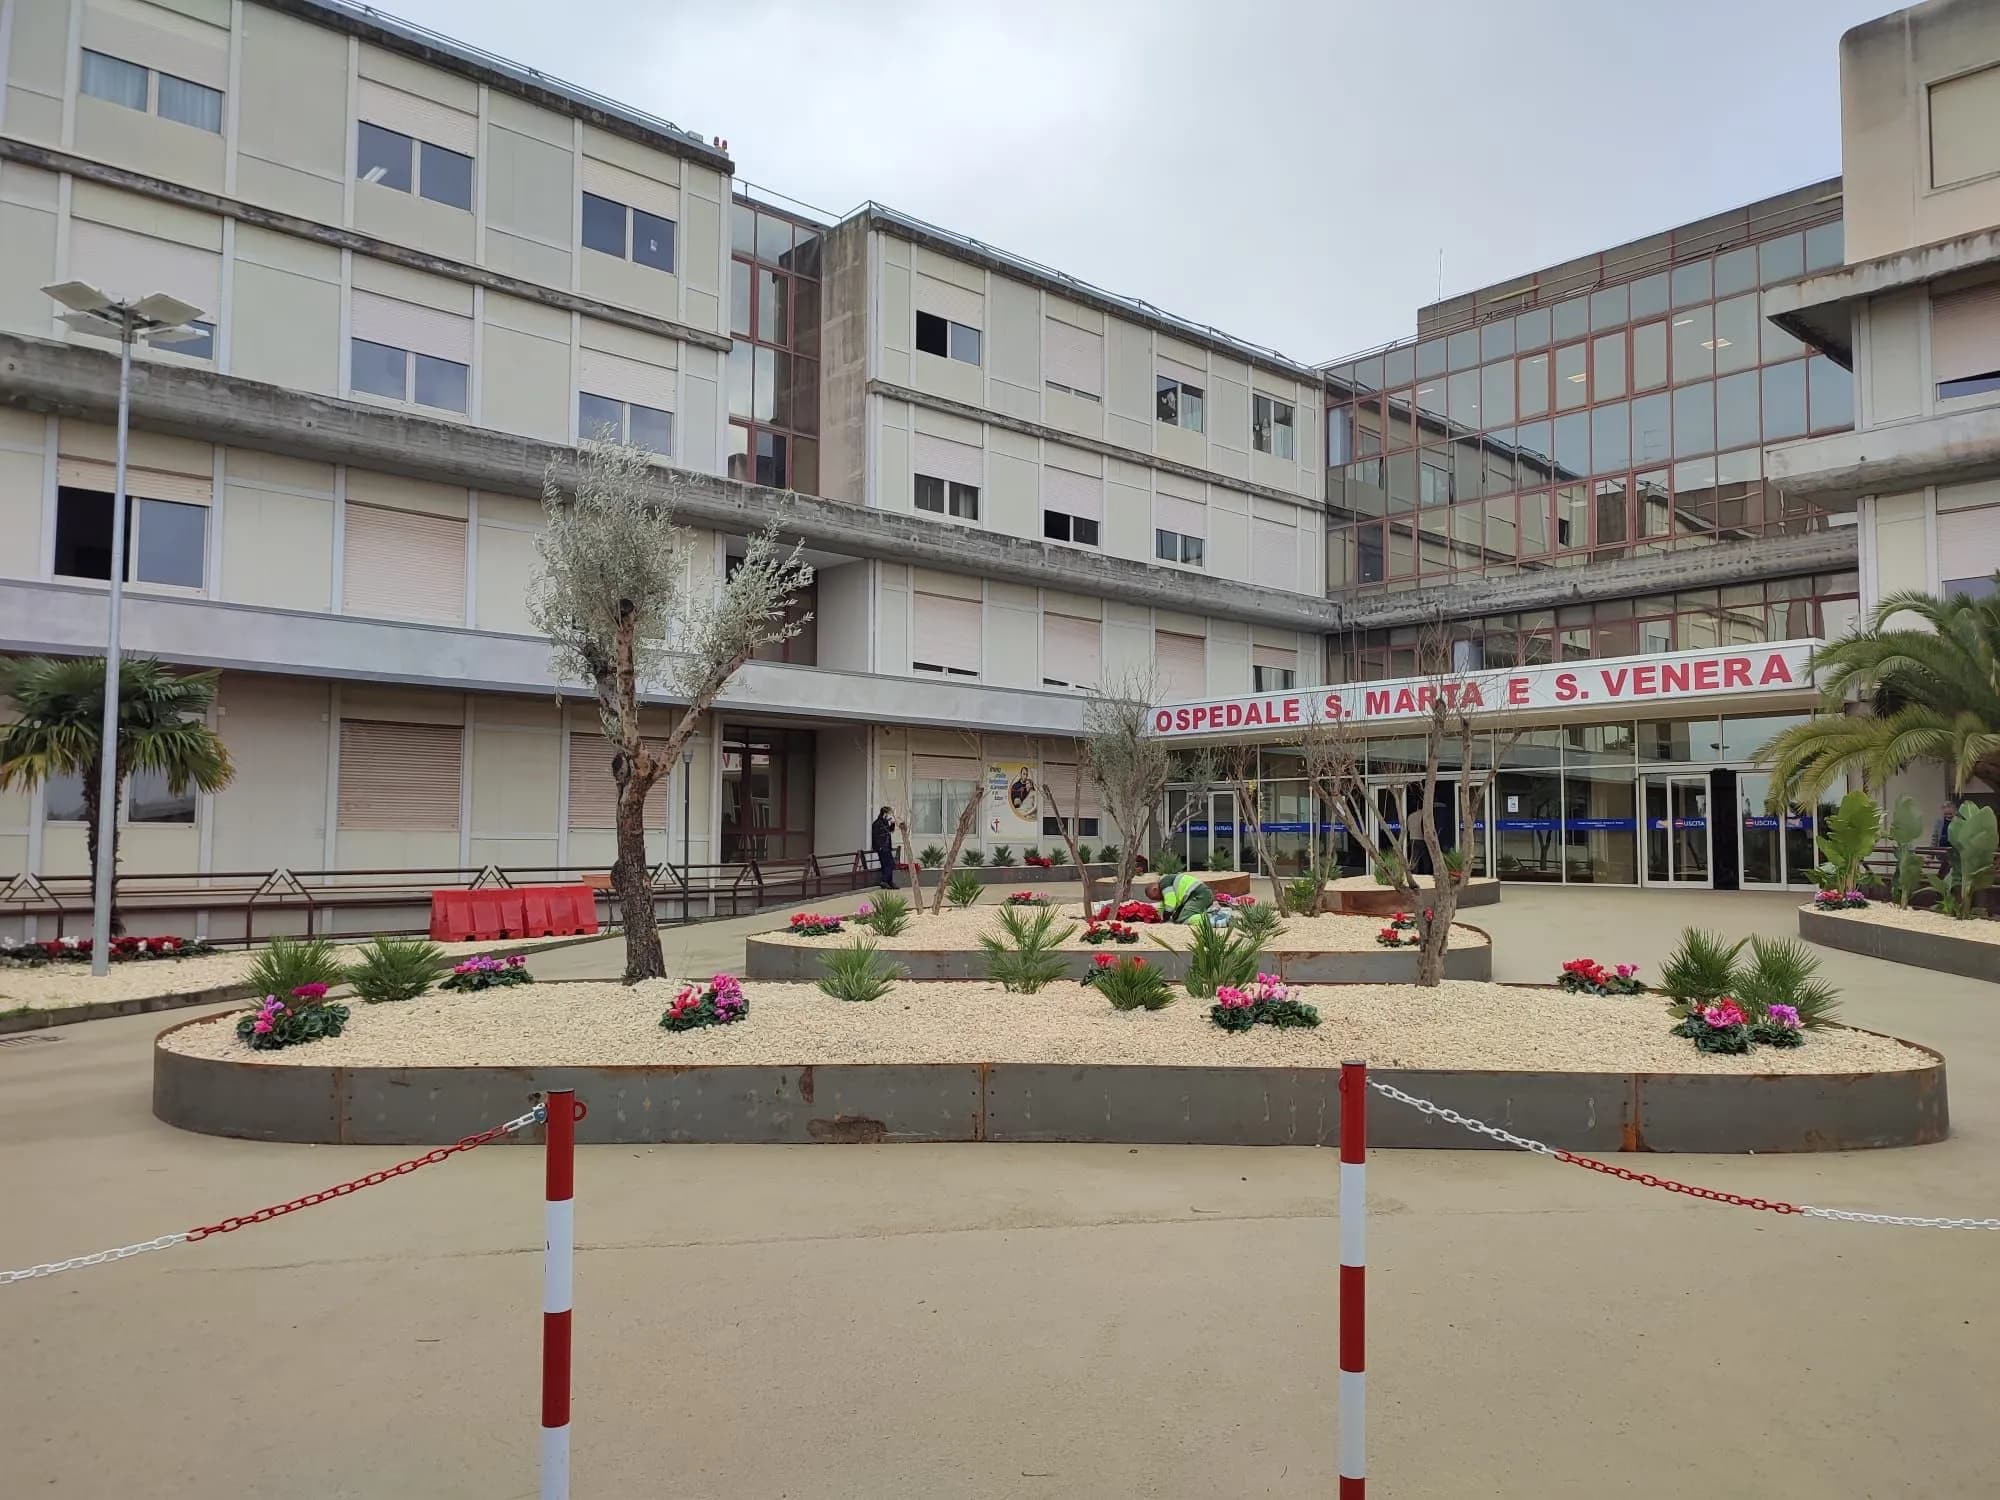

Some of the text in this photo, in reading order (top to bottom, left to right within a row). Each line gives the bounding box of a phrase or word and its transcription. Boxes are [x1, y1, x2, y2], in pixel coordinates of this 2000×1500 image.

[1156, 654, 1793, 732] OSPEDALE S. MARTA E S. VENERA
[1683, 819, 1706, 827] USCITA
[1754, 819, 1778, 827] USCITA
